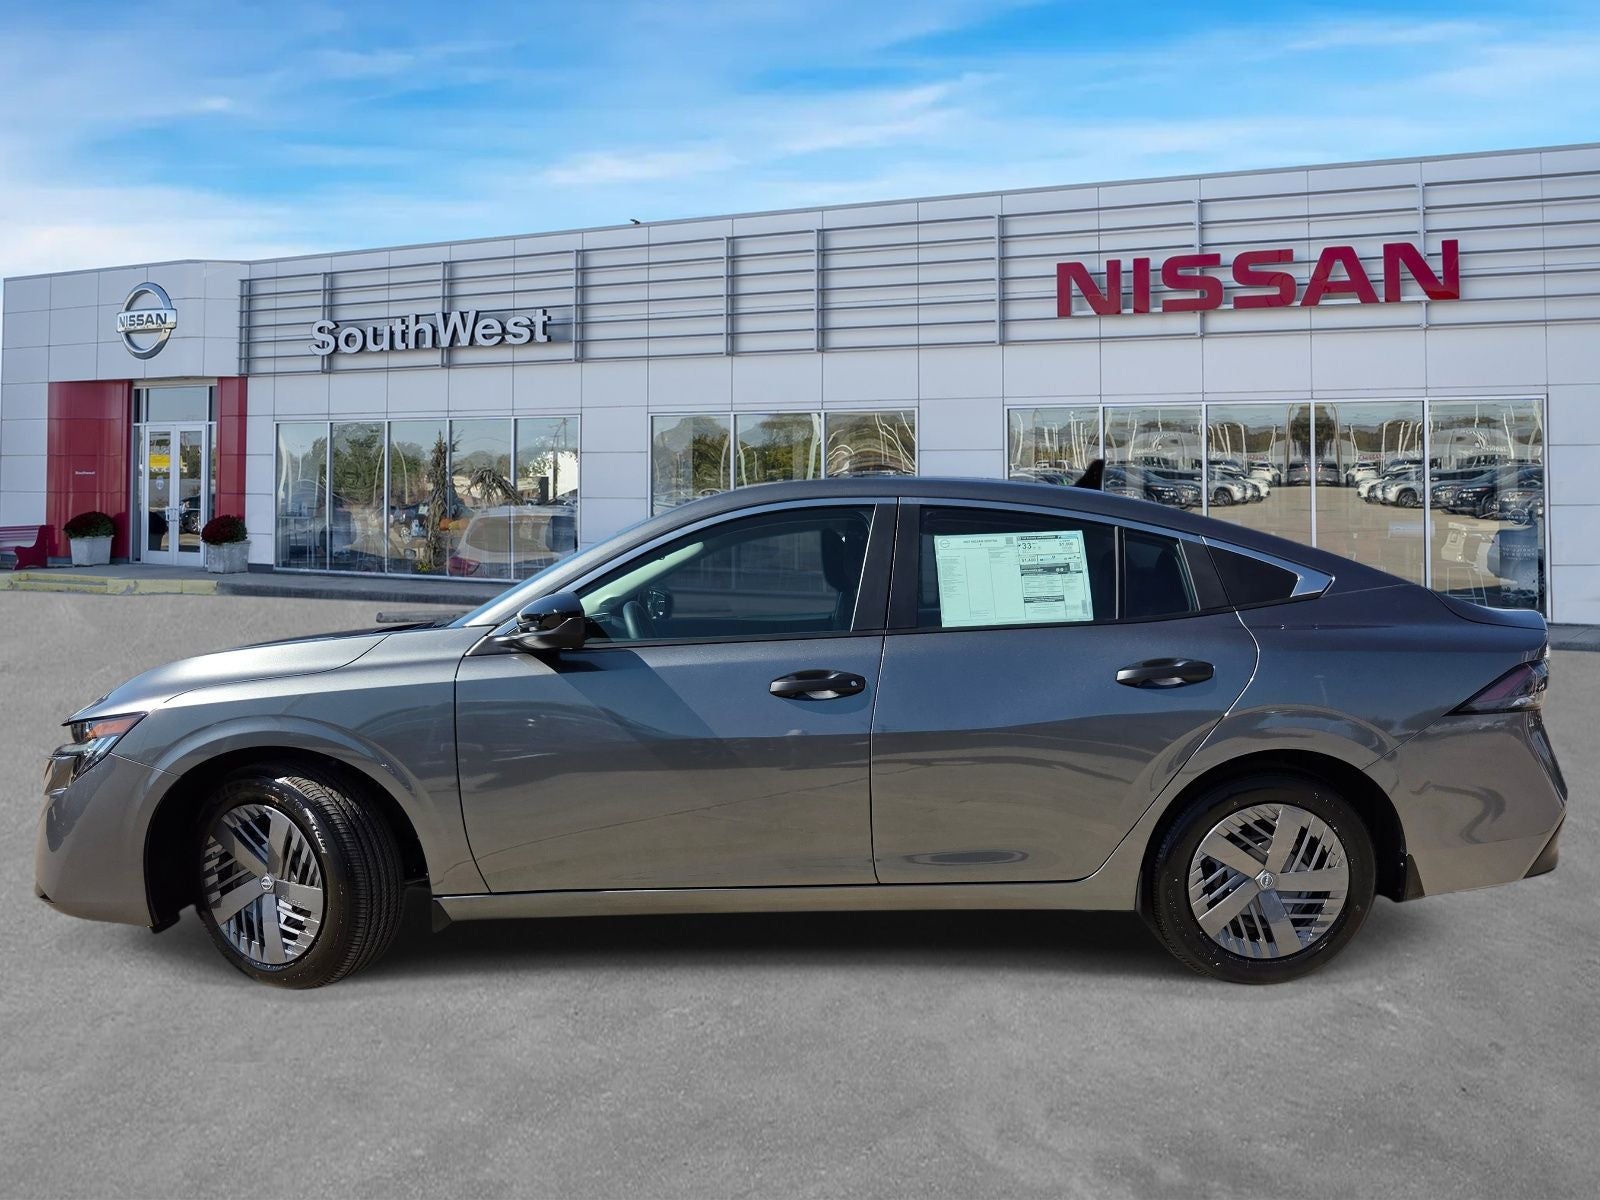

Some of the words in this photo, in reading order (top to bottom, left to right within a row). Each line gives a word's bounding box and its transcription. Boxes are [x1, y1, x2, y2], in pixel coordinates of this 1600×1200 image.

[1056, 239, 1460, 318] NISSAN
[119, 312, 167, 328] NISSAN
[309, 308, 551, 356] SouthWest
